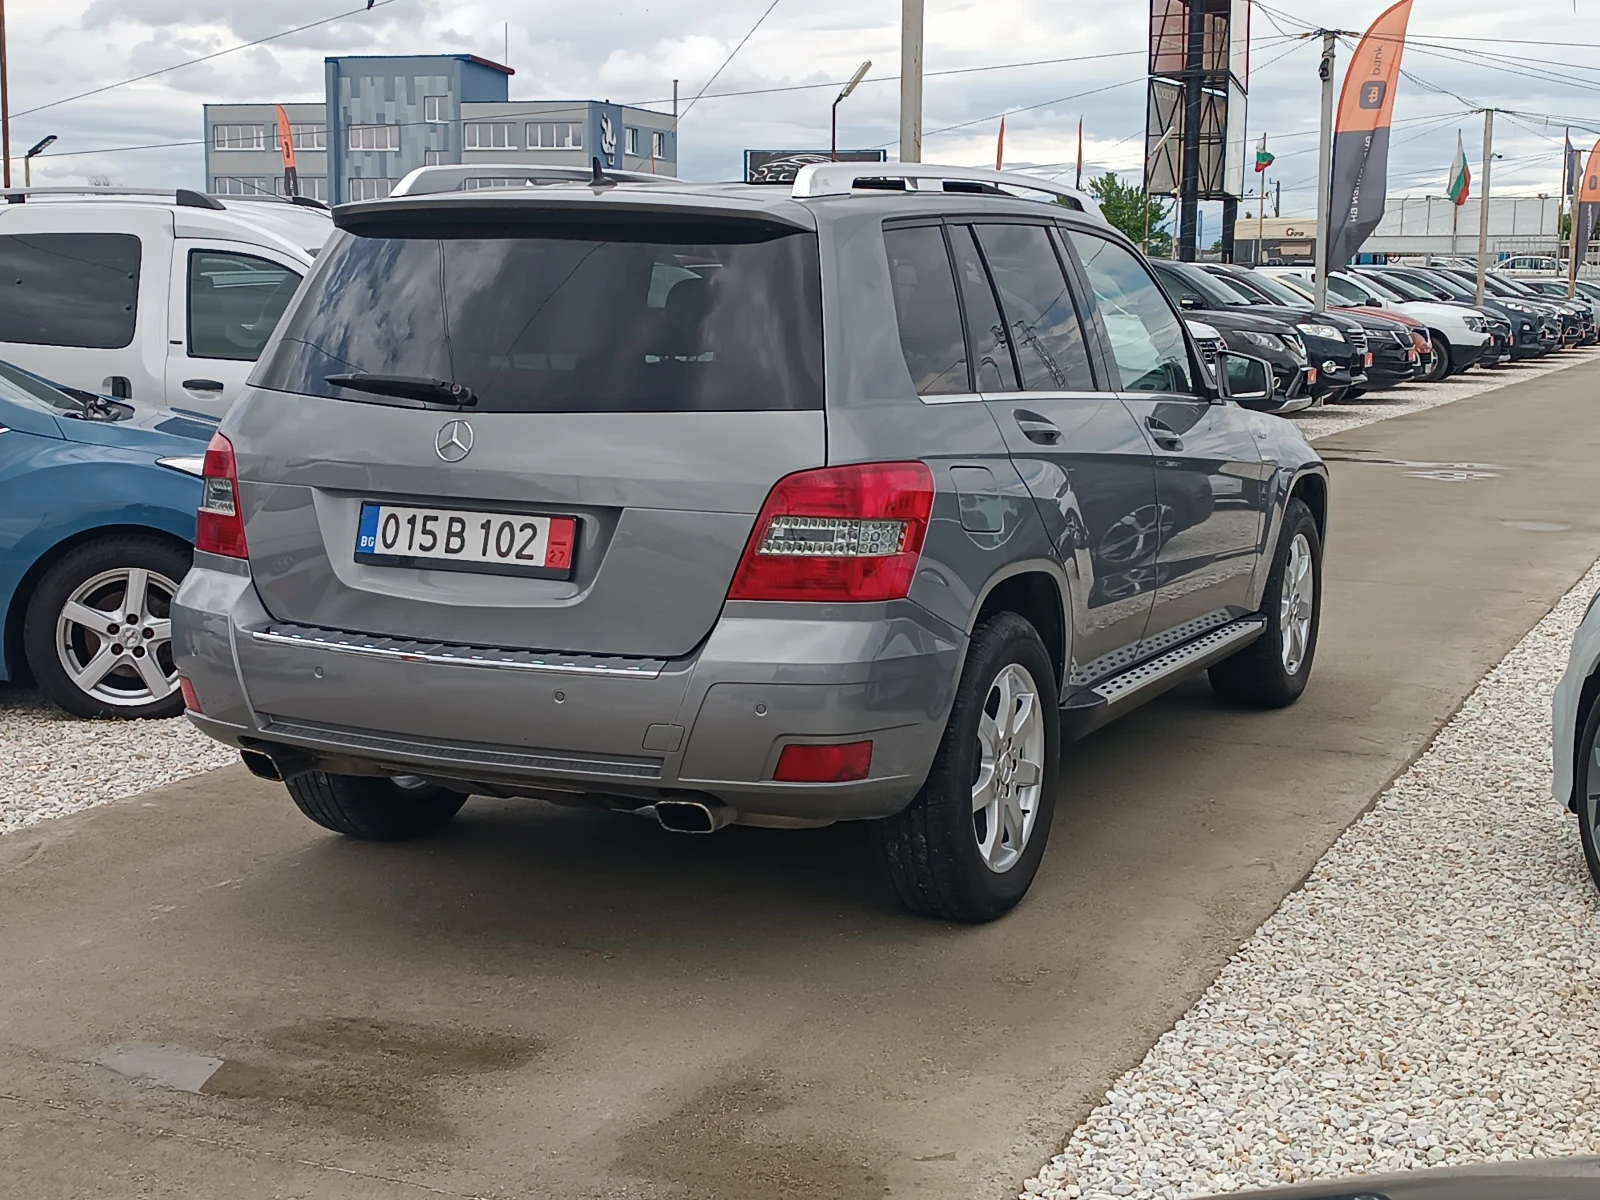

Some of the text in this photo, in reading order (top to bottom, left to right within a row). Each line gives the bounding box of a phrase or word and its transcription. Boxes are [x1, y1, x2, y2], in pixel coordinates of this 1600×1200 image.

[1368, 44, 1383, 104] tbi bank
[360, 535, 375, 548] BG
